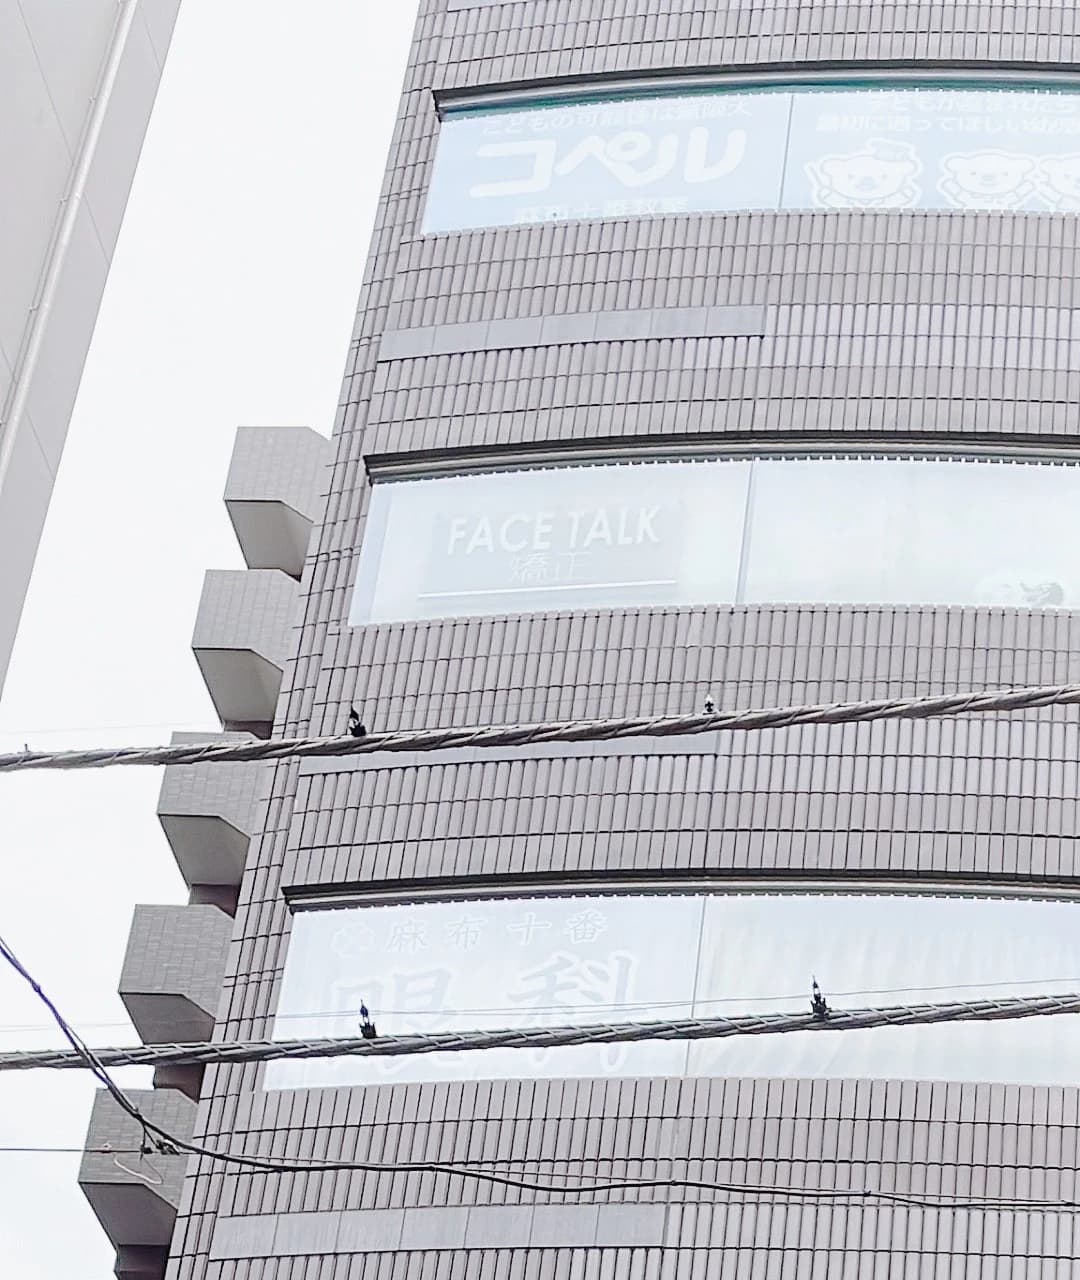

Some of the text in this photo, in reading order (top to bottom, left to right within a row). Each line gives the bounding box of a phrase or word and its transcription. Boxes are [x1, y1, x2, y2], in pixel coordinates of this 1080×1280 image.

[469, 126, 749, 198] コペル
[446, 503, 663, 556] FACE TALK
[511, 552, 598, 586] 矯正
[384, 907, 609, 954] 麻布十番
